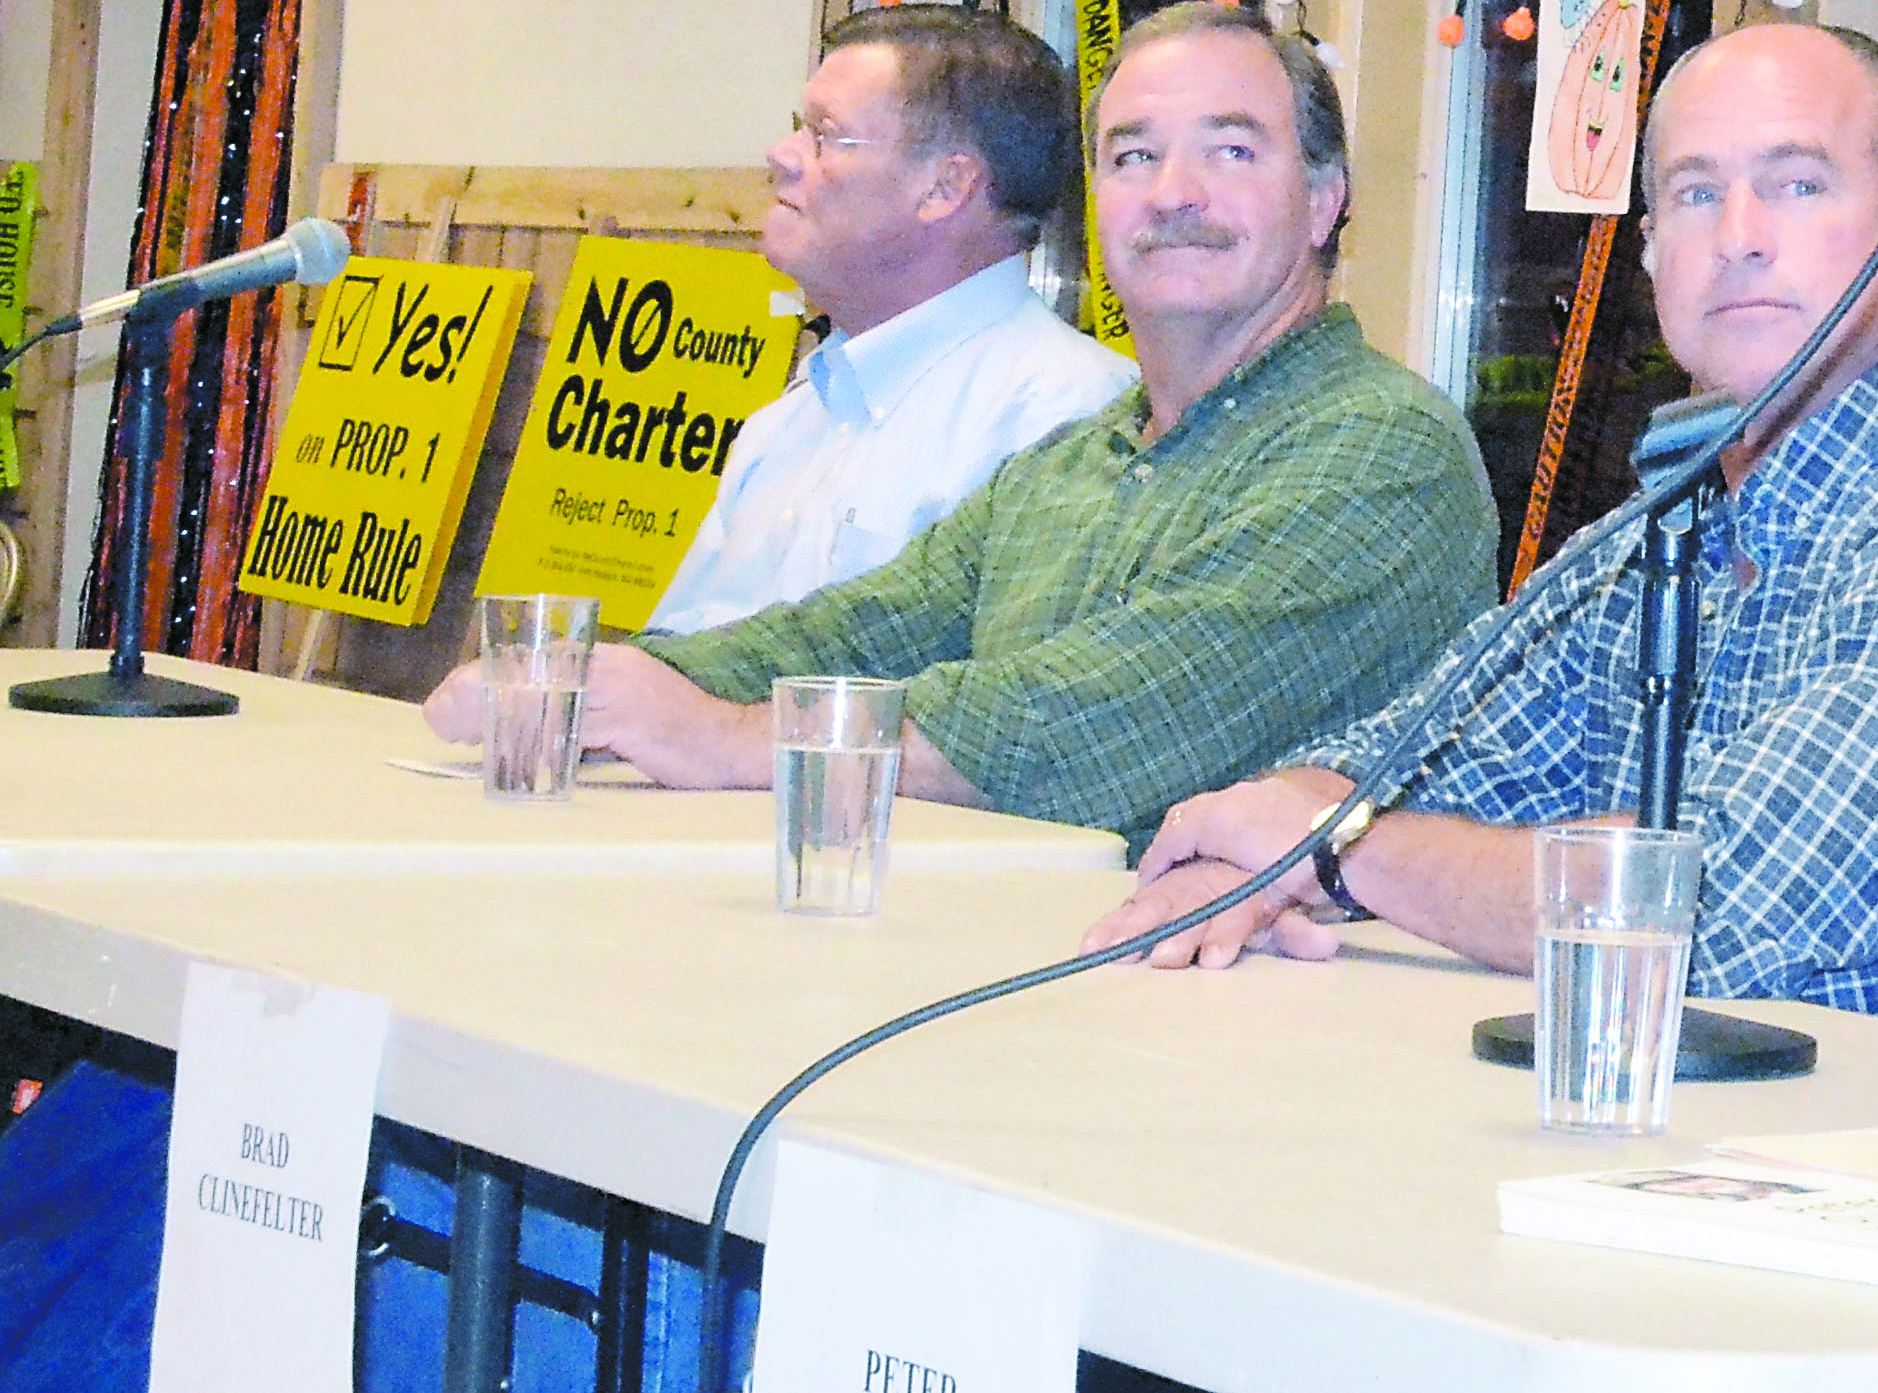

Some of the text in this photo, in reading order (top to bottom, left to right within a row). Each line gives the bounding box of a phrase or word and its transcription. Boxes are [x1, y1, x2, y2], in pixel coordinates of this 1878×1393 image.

[372, 281, 493, 384] Yes!
[566, 276, 765, 378] NO County
[296, 418, 440, 483] on PROP. 1
[547, 375, 745, 476] Charter
[247, 495, 421, 605] Home Rule
[550, 486, 680, 538] Reject Prop. 1
[241, 1123, 290, 1168] BRAD
[198, 1173, 324, 1242] CLINEFELTER
